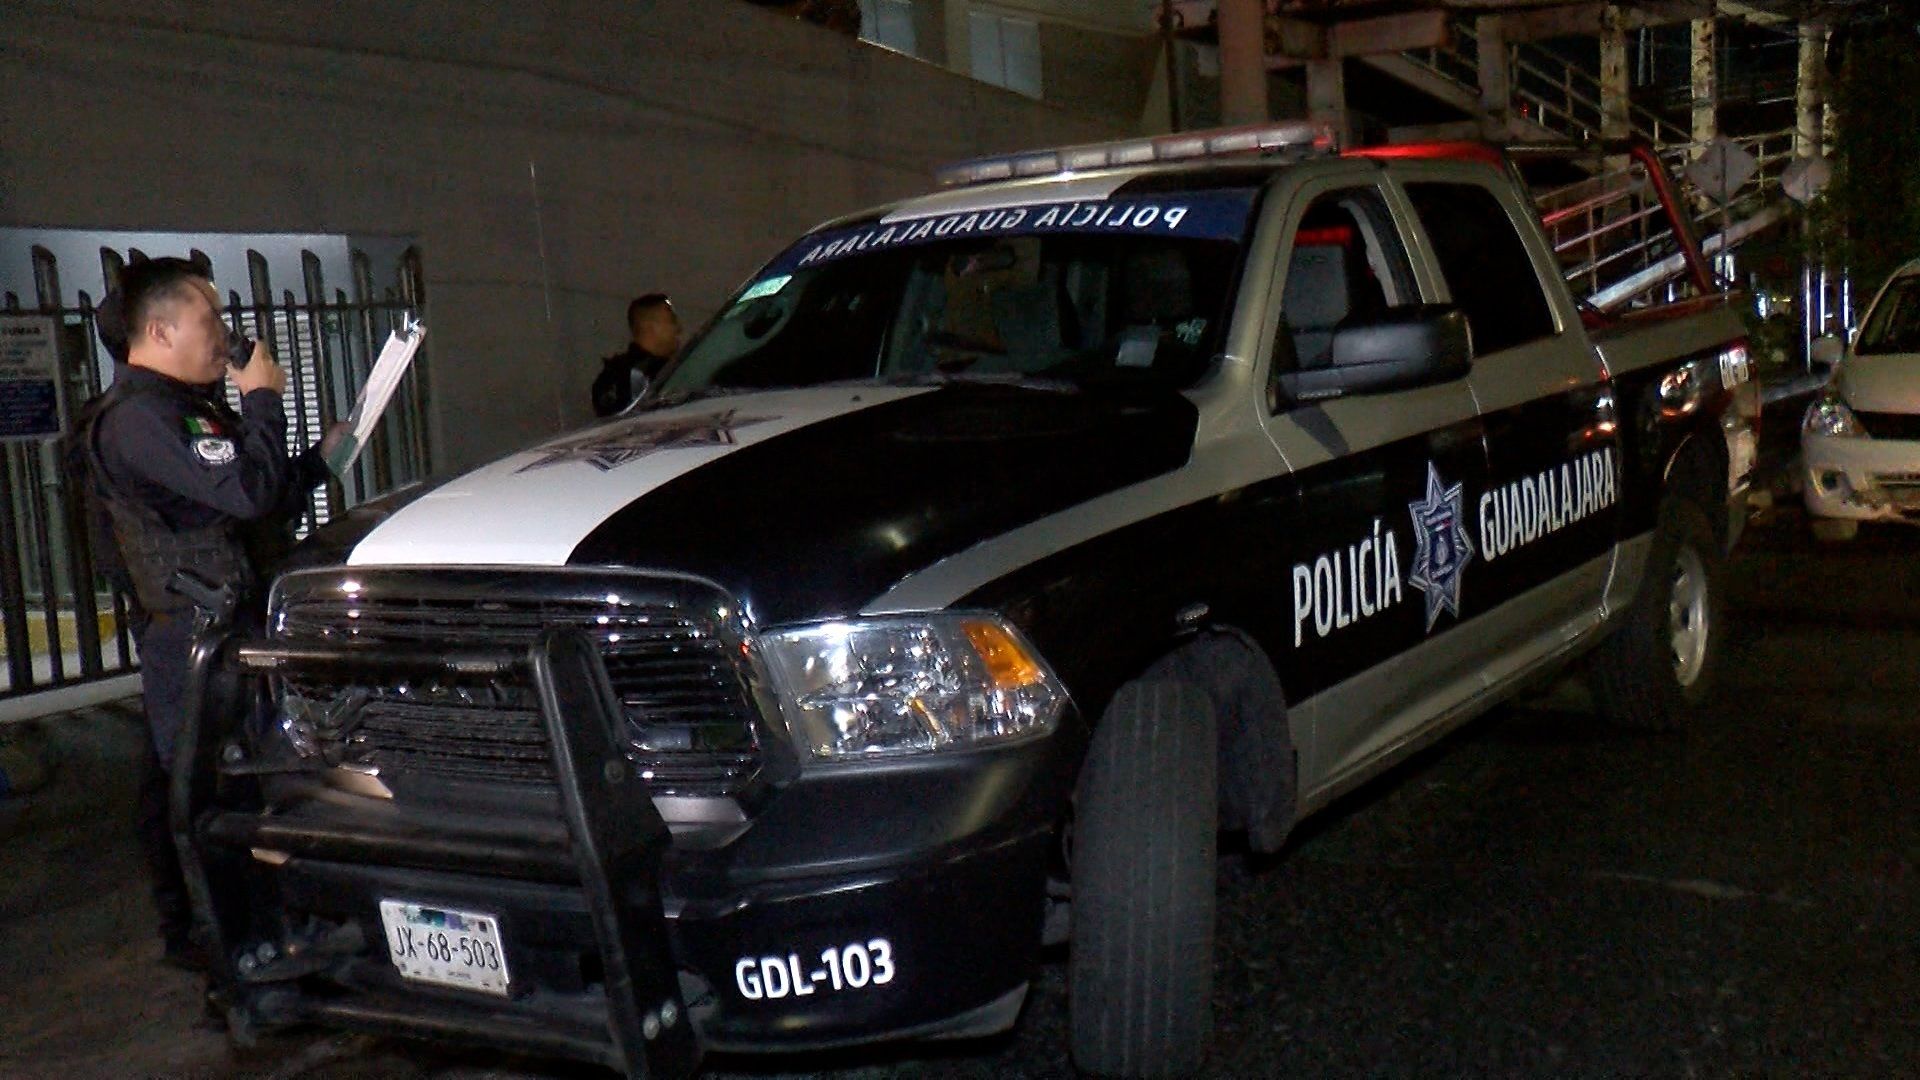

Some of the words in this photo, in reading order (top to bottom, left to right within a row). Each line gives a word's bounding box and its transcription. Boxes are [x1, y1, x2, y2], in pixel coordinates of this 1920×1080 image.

[1293, 518, 1402, 647] POLICÍA
[1479, 448, 1616, 561] GUADALAJARA
[395, 926, 499, 970] JX-68-503
[736, 939, 895, 999] GDL-103
